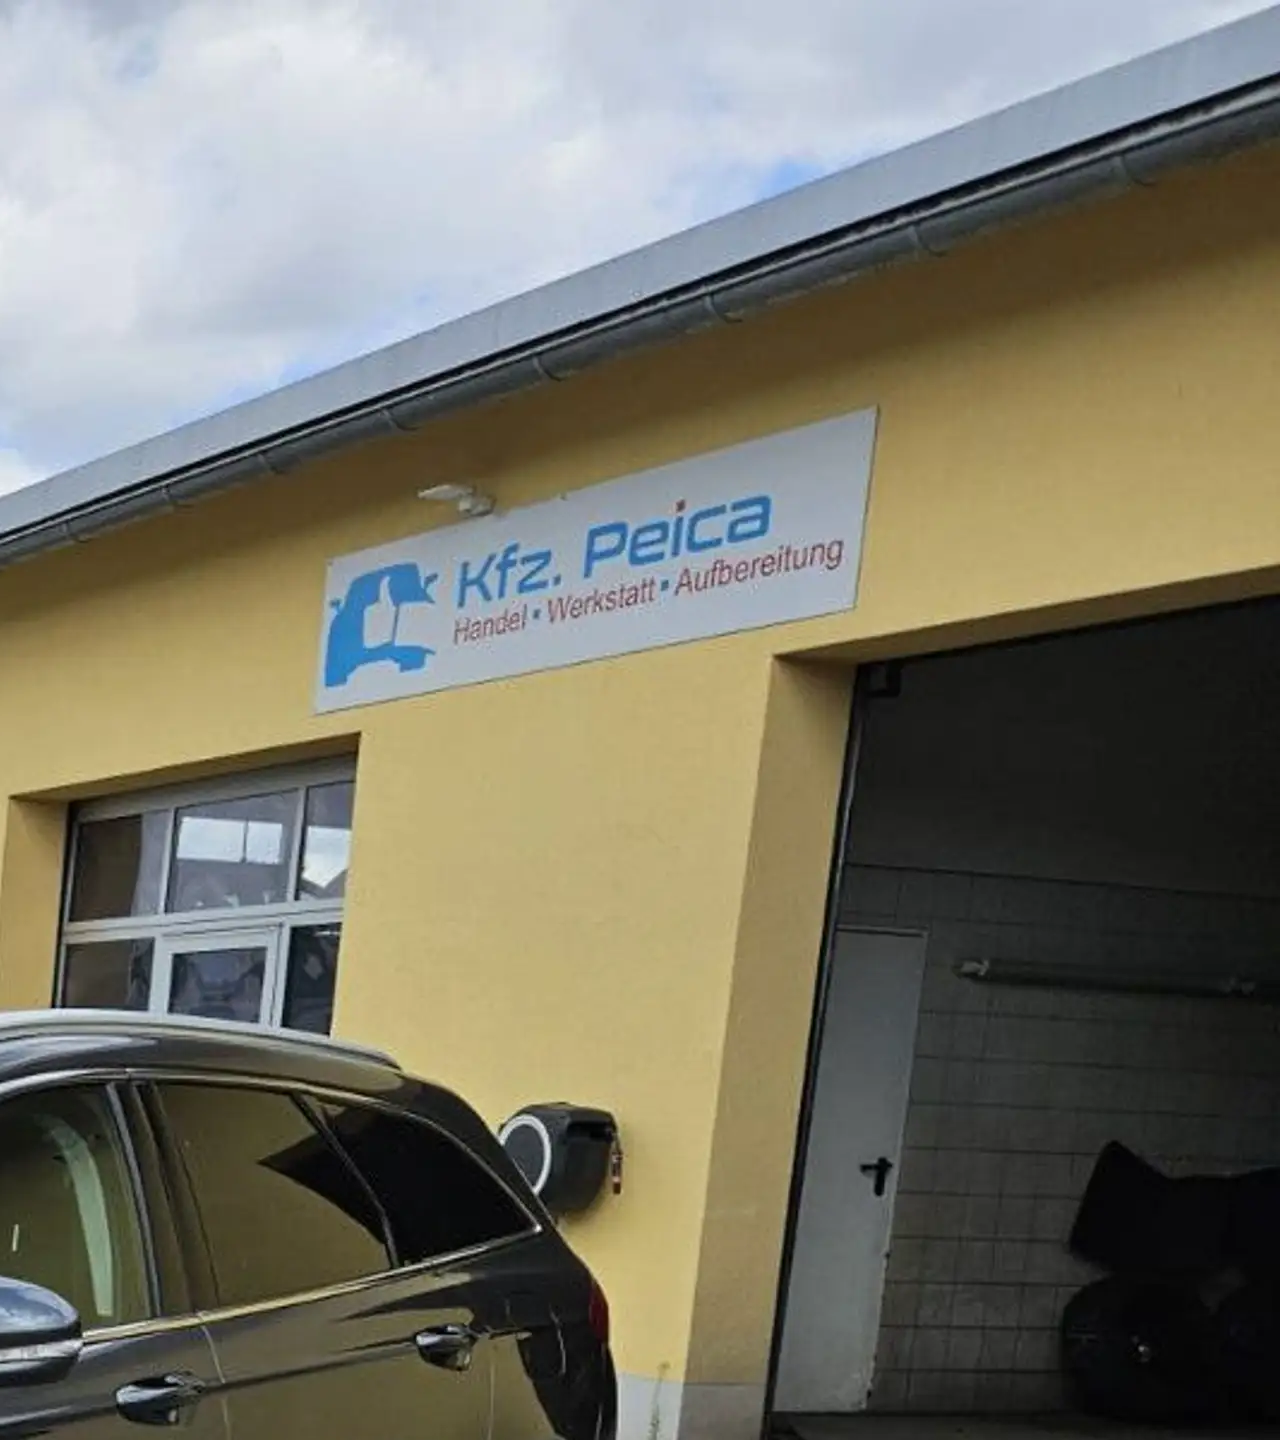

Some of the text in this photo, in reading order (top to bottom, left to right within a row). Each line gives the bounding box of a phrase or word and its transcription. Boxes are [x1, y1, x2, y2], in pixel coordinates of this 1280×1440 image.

[453, 539, 845, 645] Handel Werkstatt Aufbereitung
[457, 495, 773, 608] Kfz. Peica
